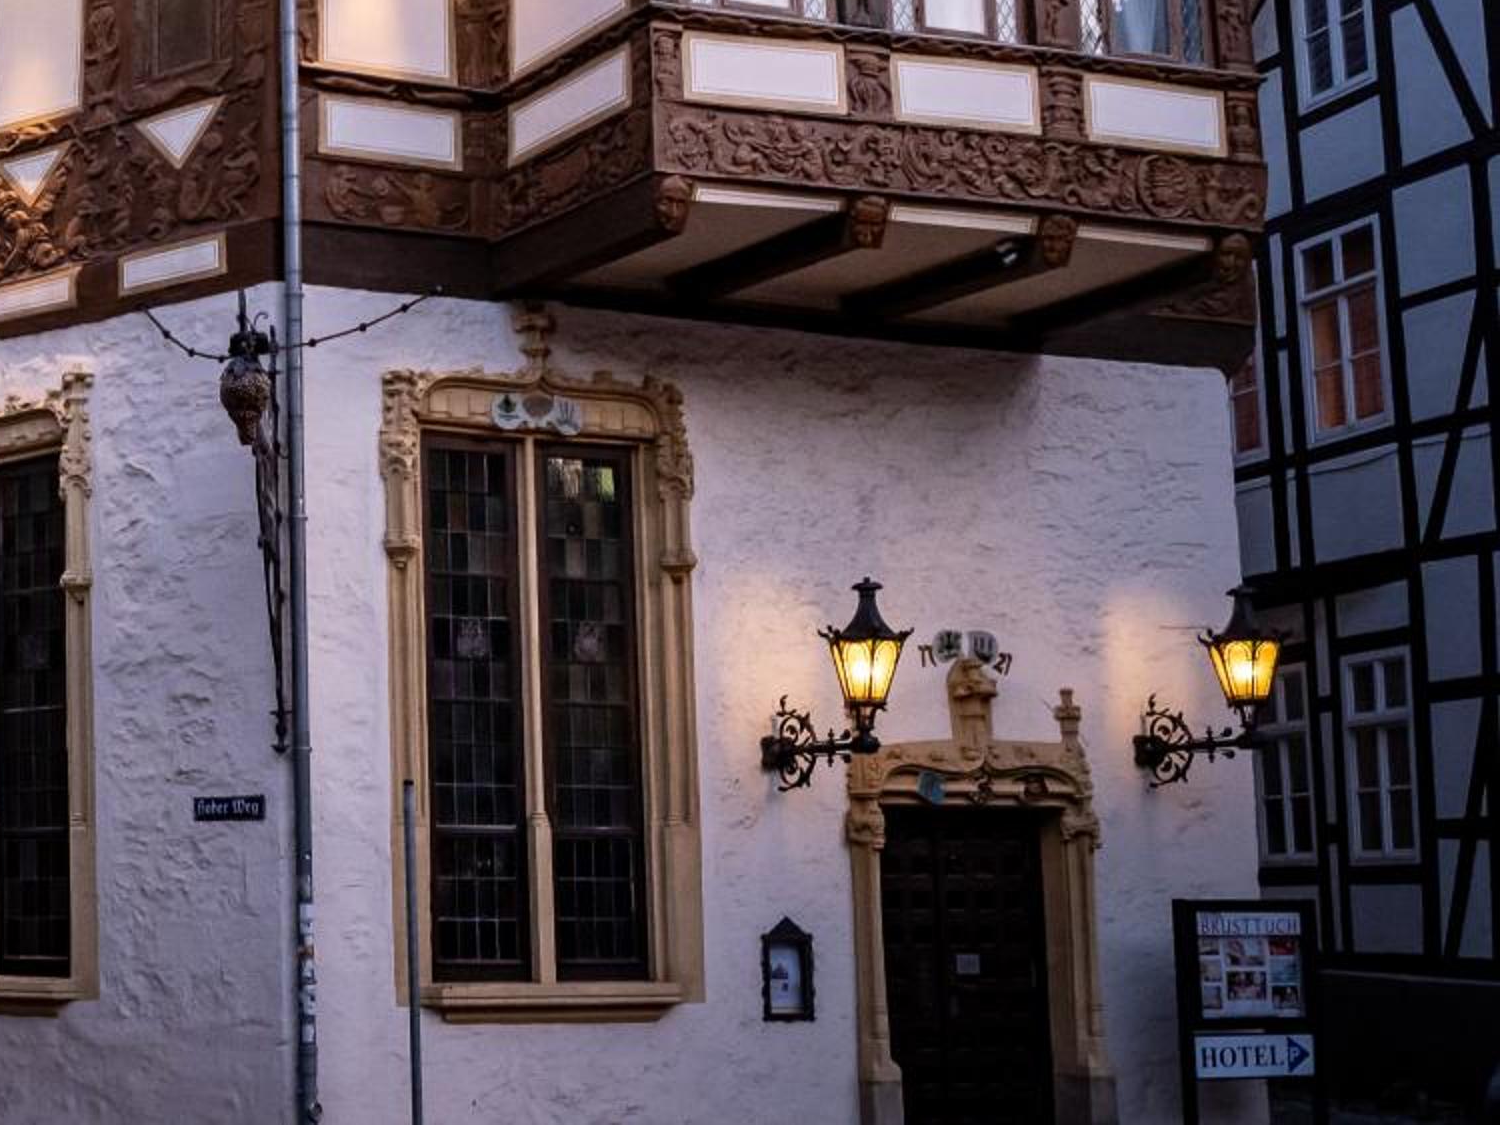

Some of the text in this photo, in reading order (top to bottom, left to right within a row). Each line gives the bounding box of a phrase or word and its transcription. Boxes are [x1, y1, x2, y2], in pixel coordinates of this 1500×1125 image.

[232, 799, 259, 815] Weg
[1201, 917, 1297, 934] BRUSTTUCH
[1201, 1045, 1284, 1068] HOTEL
